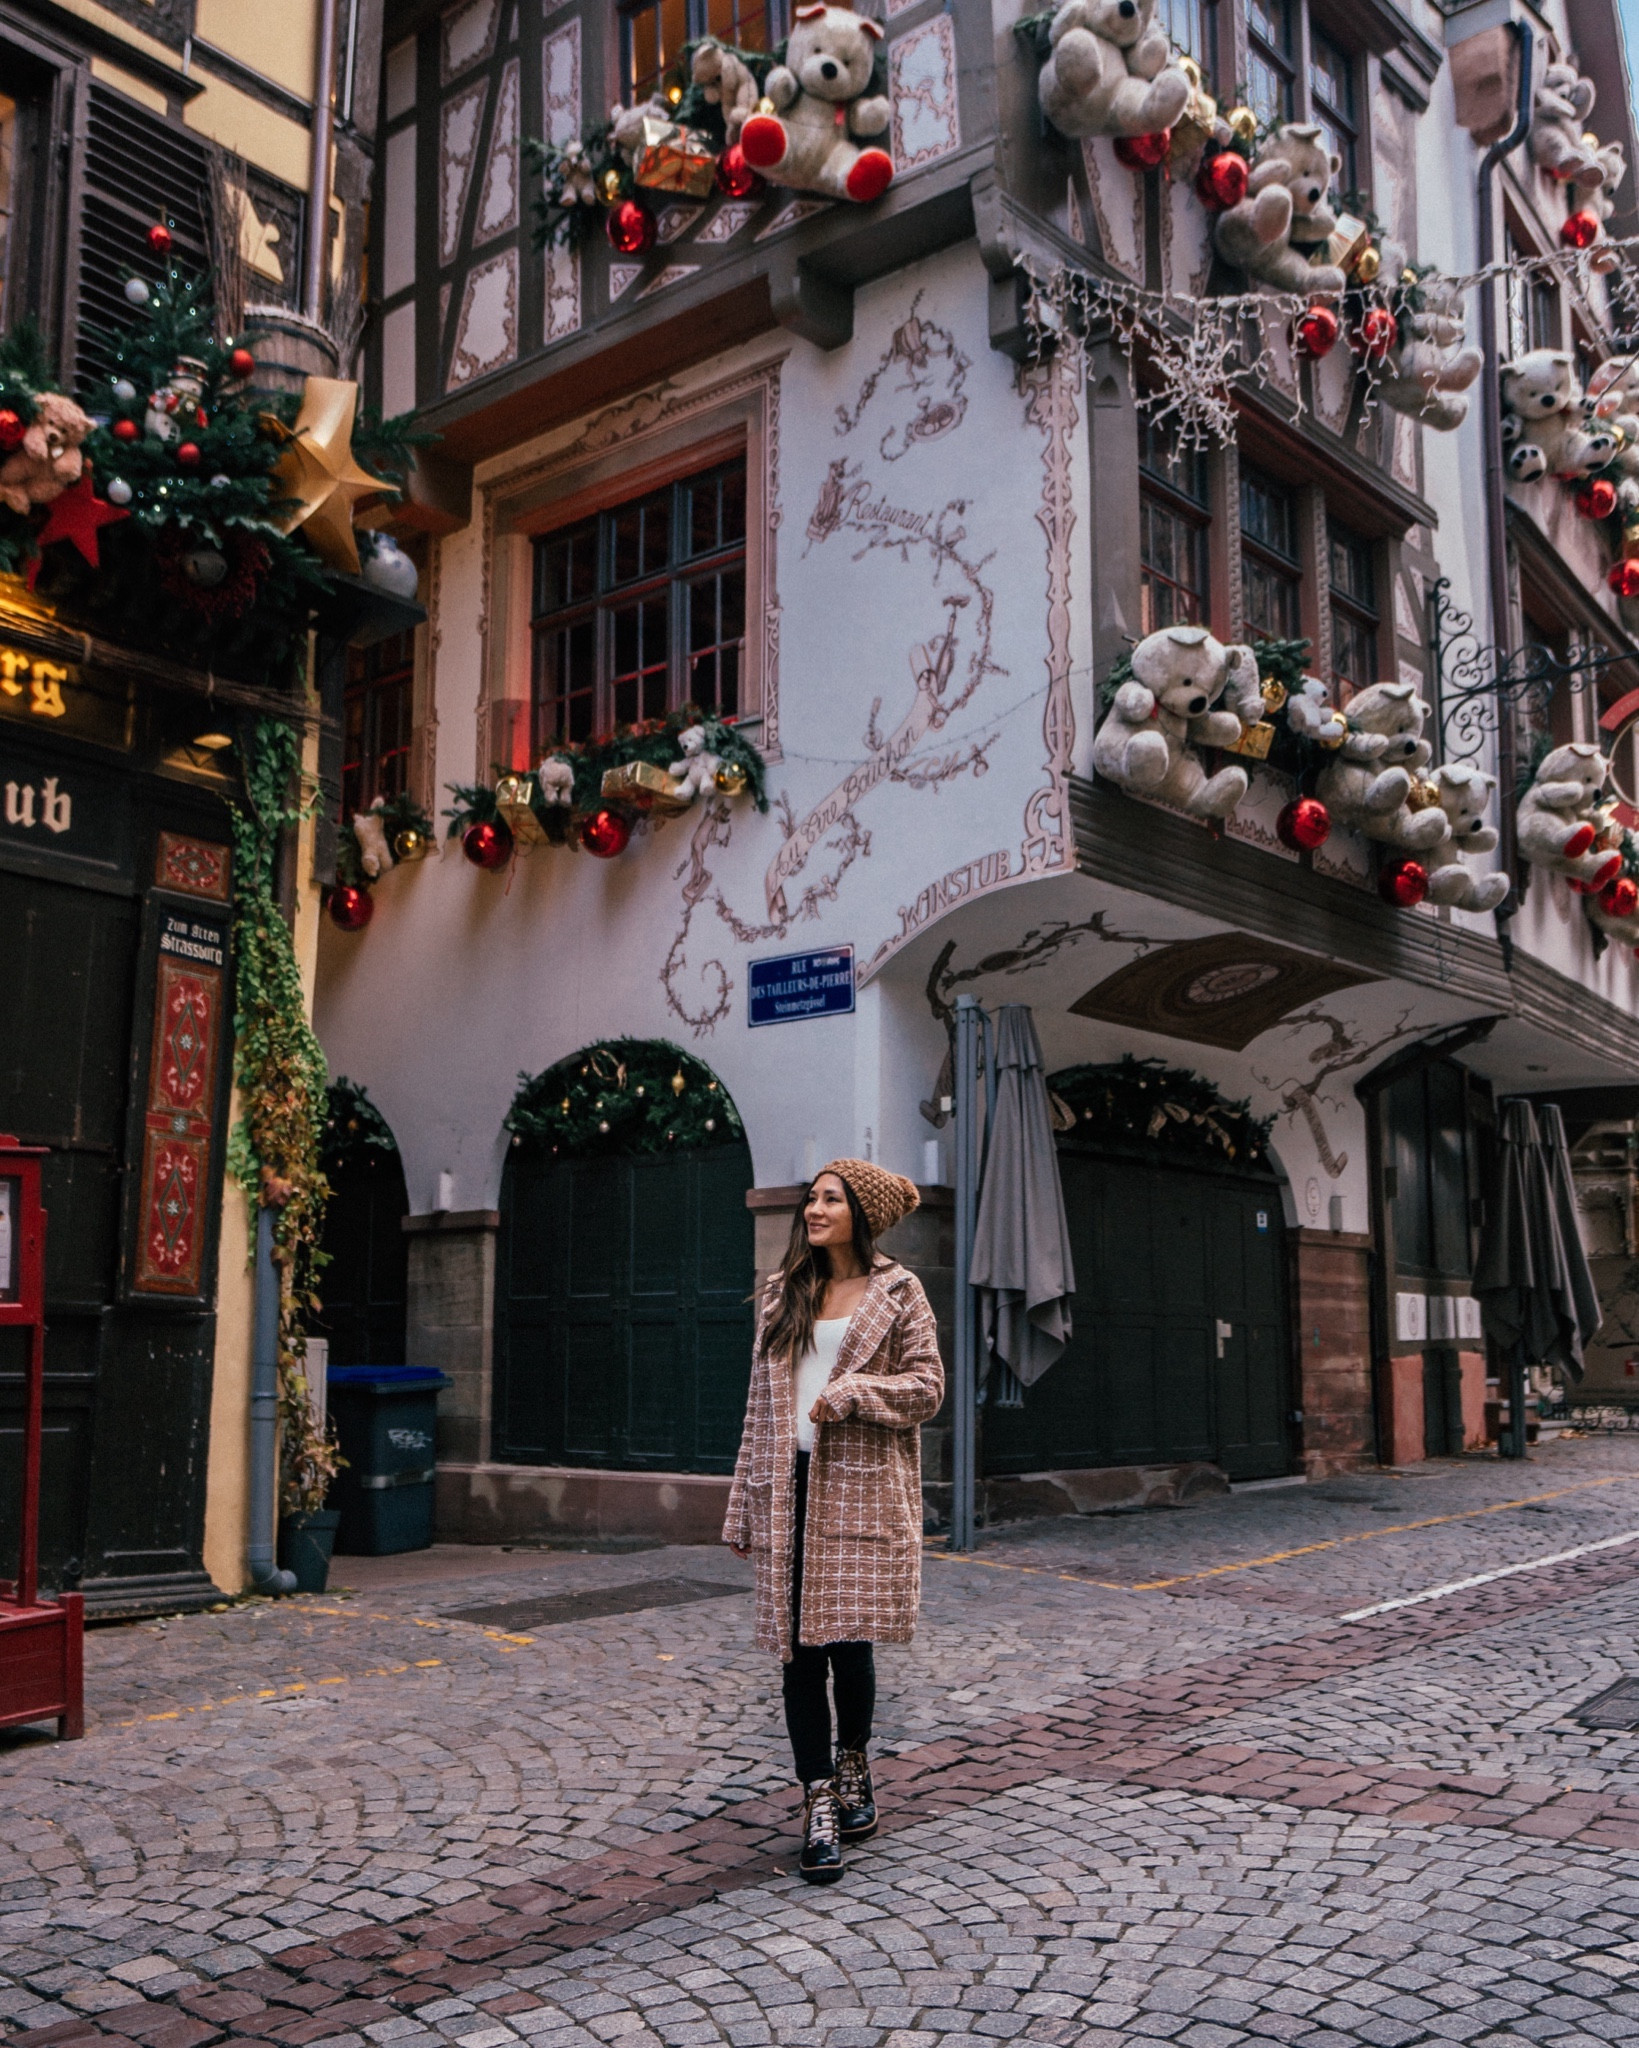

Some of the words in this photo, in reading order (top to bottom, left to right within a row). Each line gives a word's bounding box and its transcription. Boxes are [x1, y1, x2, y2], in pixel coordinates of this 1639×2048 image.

[841, 480, 935, 535] Restaurant
[842, 726, 918, 809] Bouchon
[4, 776, 73, 833] ub
[897, 850, 1011, 934] WINSTUB
[167, 917, 188, 934] Zum
[160, 933, 223, 965] Strassburg
[791, 959, 807, 974] RUE
[752, 986, 765, 999] DES
